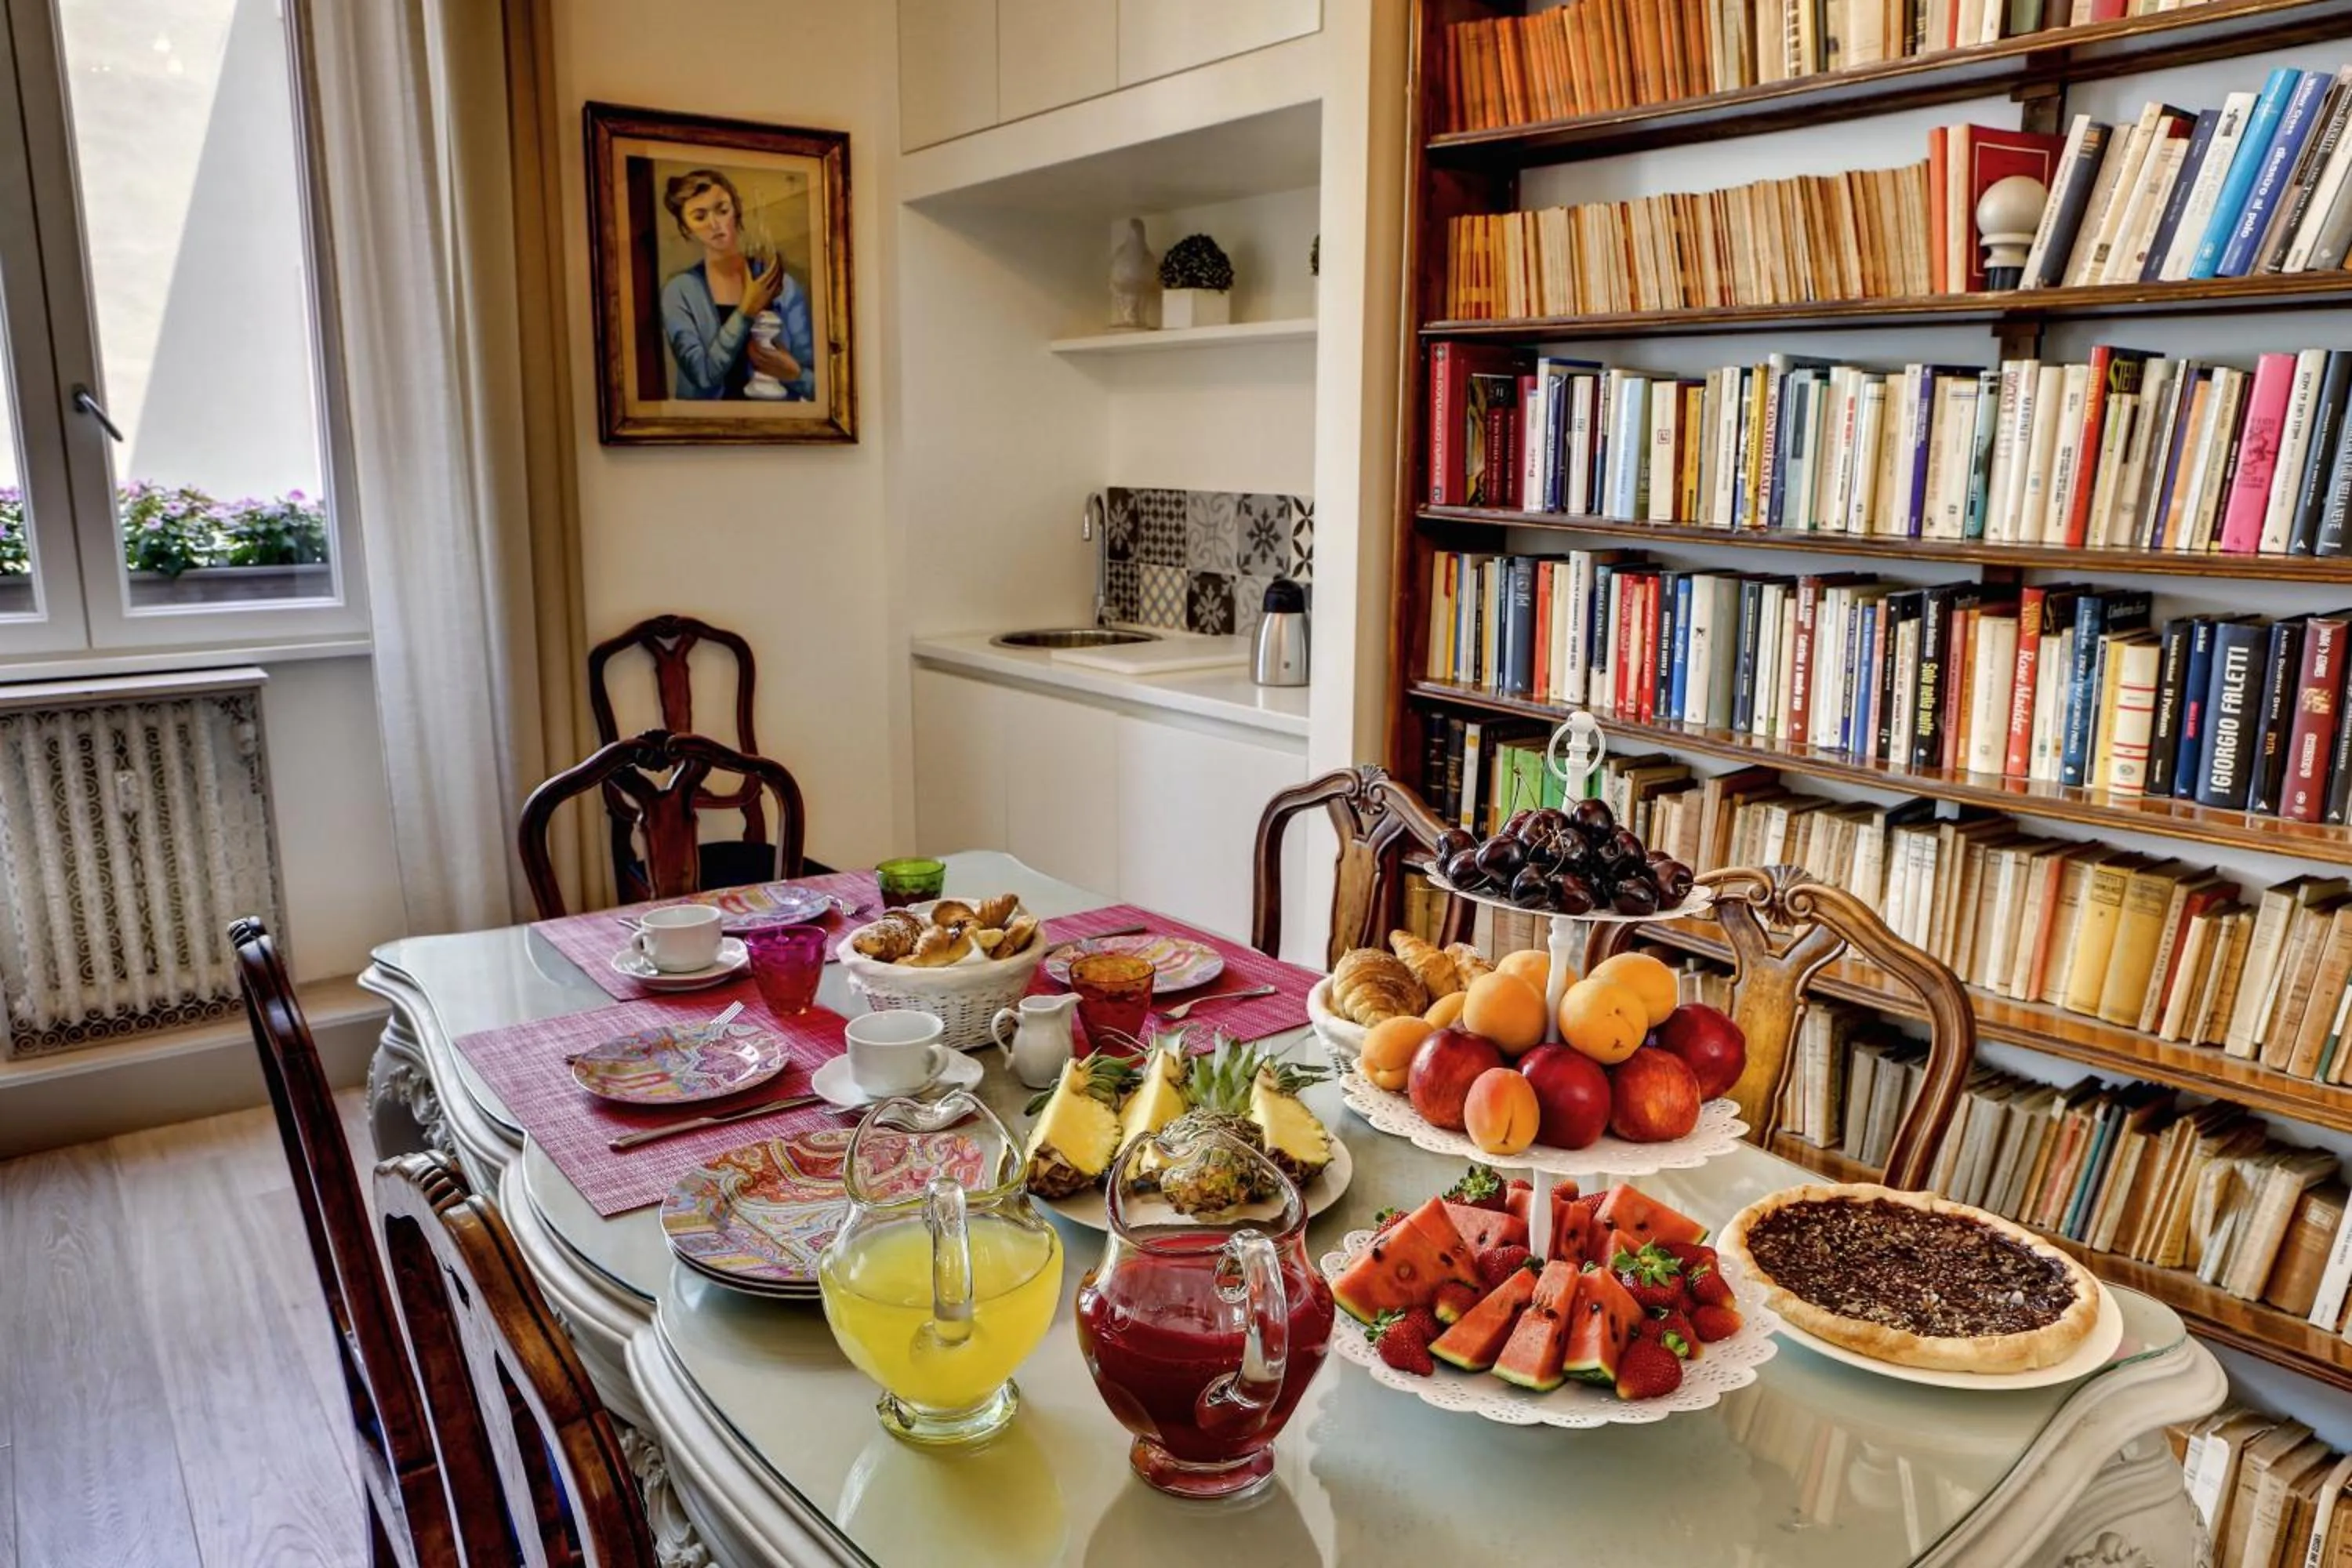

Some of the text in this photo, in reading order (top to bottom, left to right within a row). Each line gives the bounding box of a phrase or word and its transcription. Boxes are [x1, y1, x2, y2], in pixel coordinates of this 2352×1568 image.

[2240, 147, 2288, 239] disastro al polo
[2329, 508, 2345, 529] NEVE
[1917, 662, 1939, 736] Solo nella notte
[2012, 648, 2035, 735] Rose Madder
[2220, 645, 2249, 714] FALETTI
[2158, 697, 2173, 738] Profumo
[2263, 731, 2278, 756] EVITA
